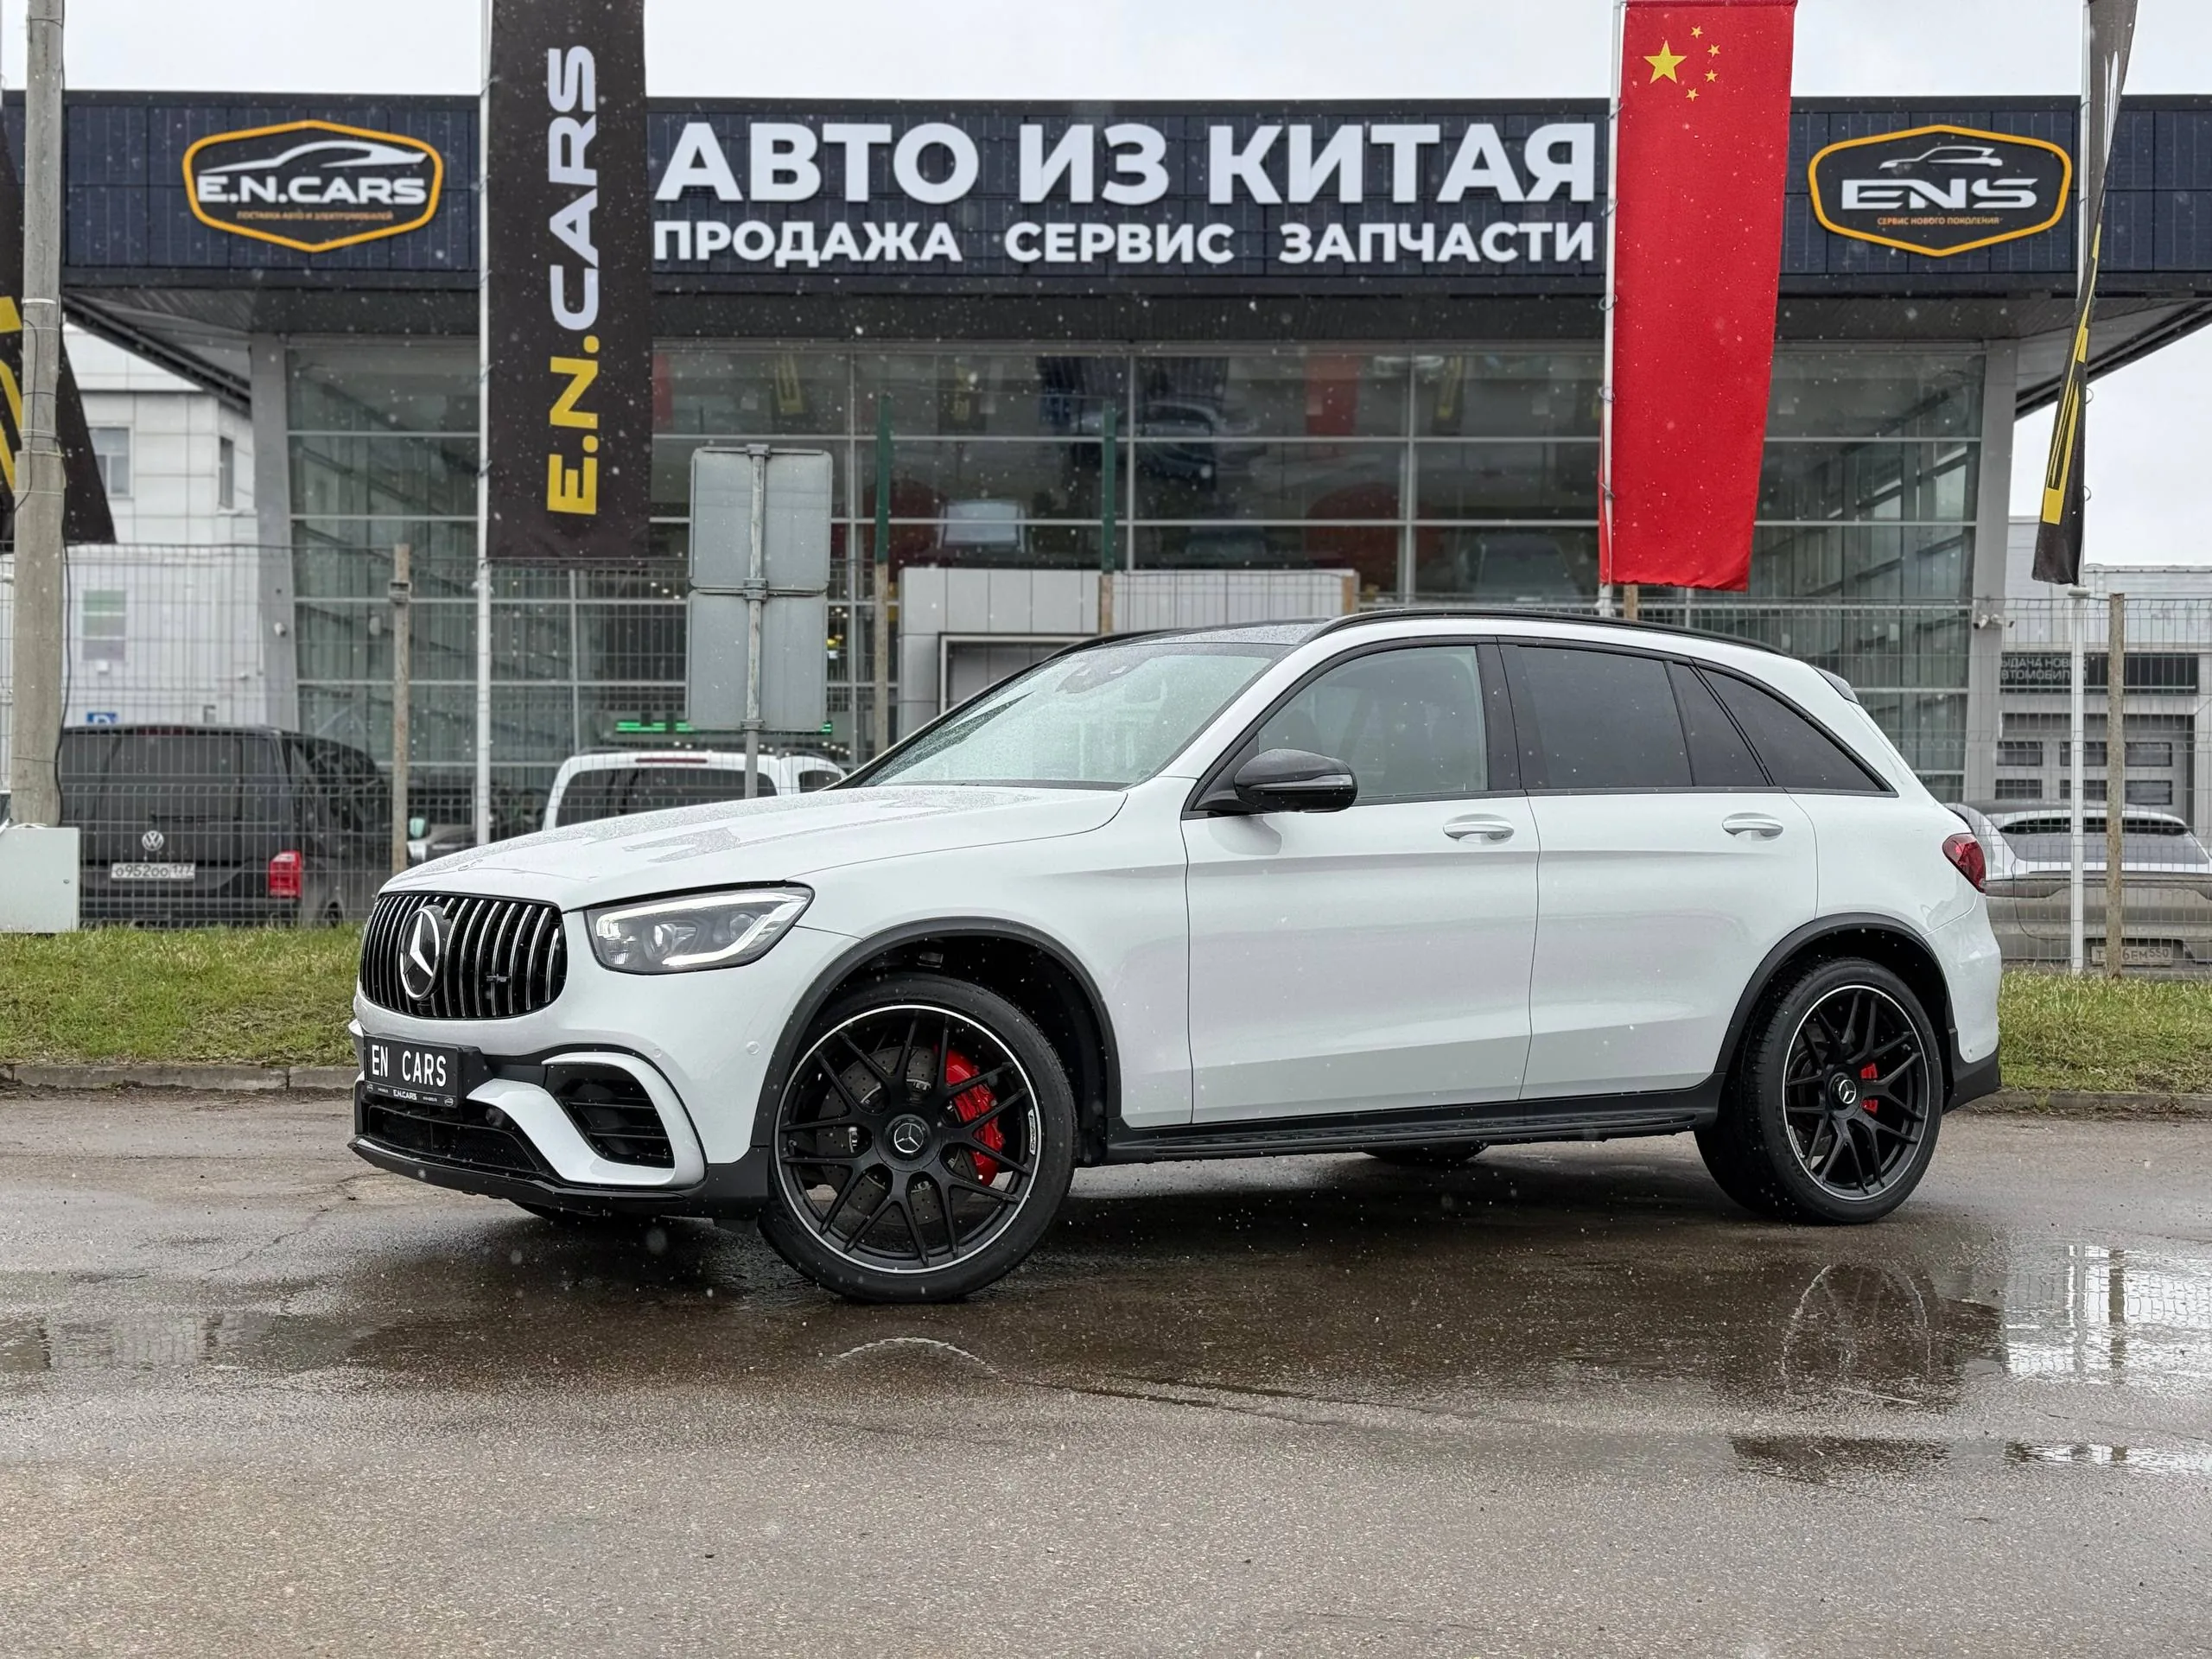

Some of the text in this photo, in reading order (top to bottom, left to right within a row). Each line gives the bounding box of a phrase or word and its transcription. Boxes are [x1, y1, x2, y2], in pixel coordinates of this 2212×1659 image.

[654, 122, 1595, 206] АВТО ИЗ КИТАЯ
[196, 175, 427, 205] E.N.CARS
[1840, 178, 2038, 210] ENS
[1877, 216, 2001, 226] СЕРВИС НОВОГО ПОКОЛЕНИЯ
[653, 220, 1594, 269] ПРОДАЖА СЕРВИС ЗАПЧАСТИ
[547, 45, 600, 515] E.N.CARS
[2001, 657, 2044, 668] ЫДАЧА
[371, 1044, 448, 1087] EN CARS
